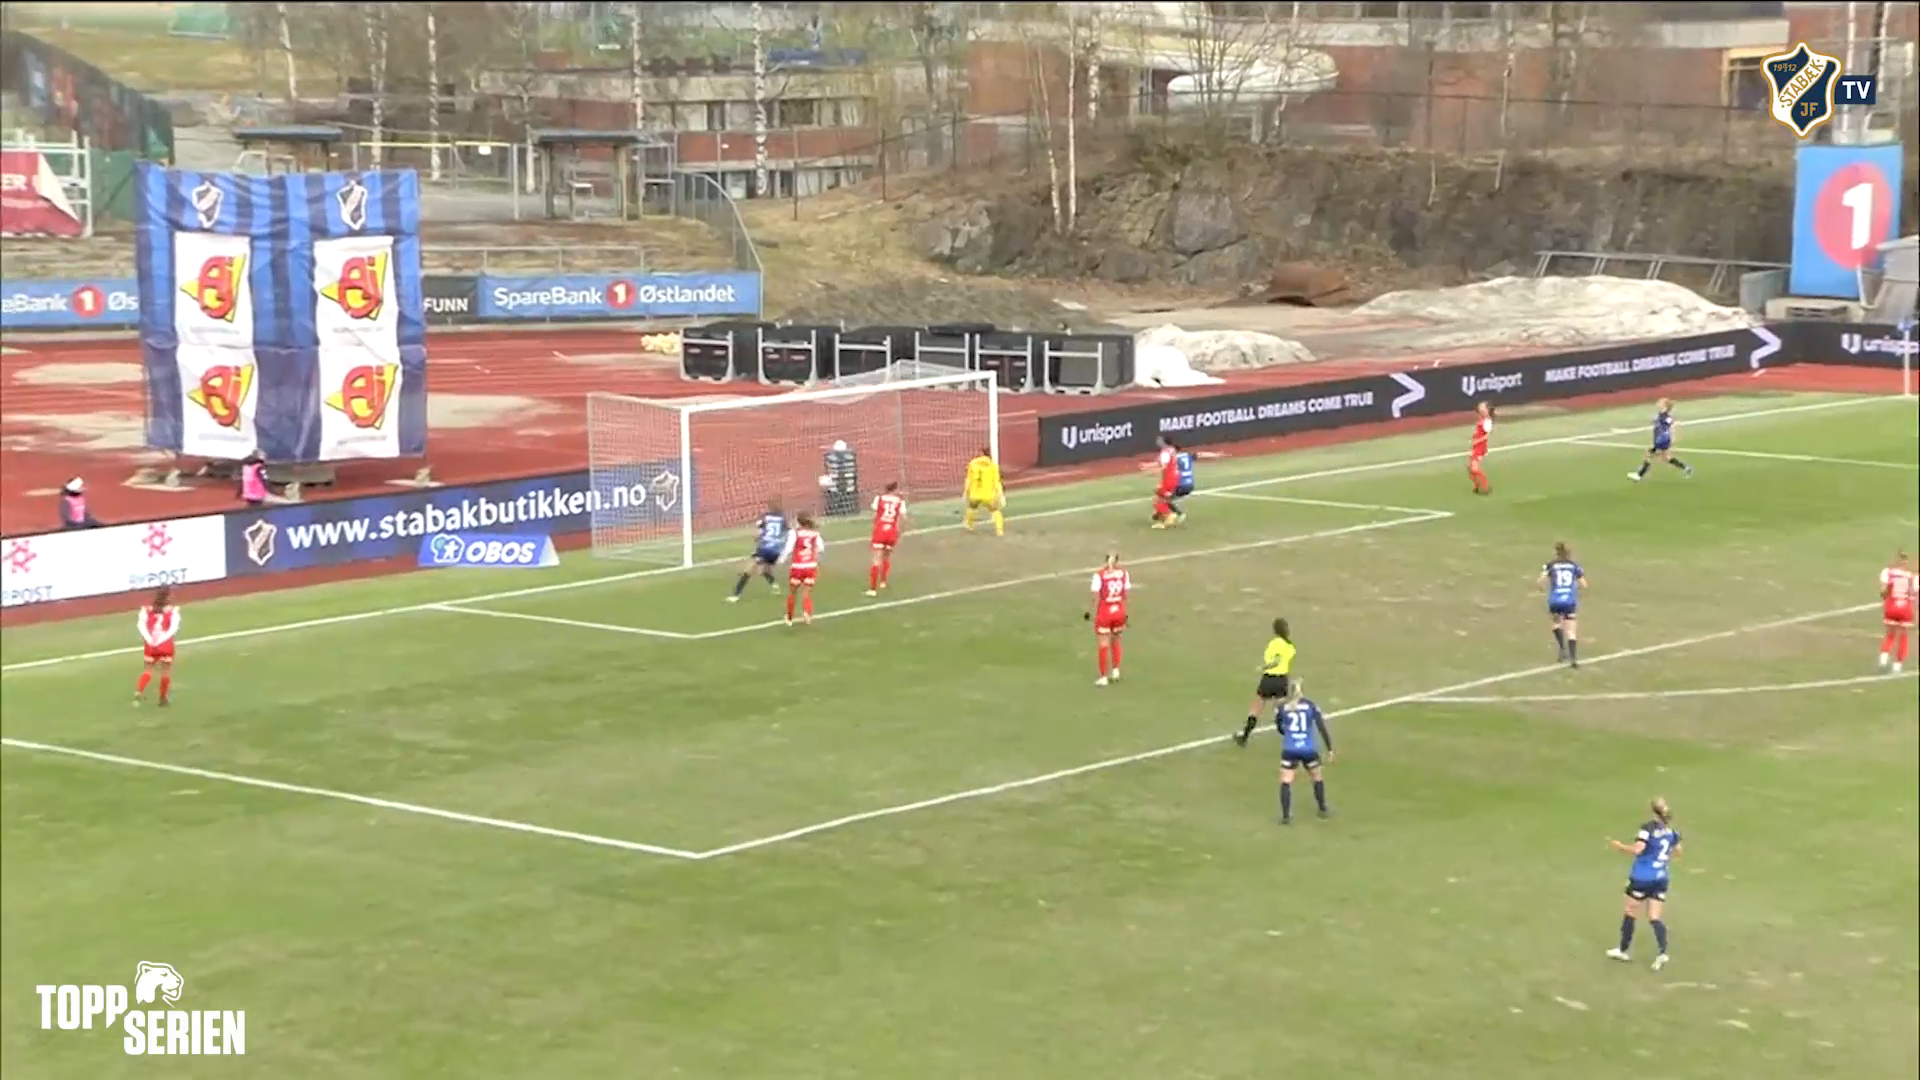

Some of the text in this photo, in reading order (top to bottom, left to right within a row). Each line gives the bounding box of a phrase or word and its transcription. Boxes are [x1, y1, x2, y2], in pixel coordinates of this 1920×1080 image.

[1842, 182, 1873, 250] 1
[79, 289, 95, 312] 1
[494, 283, 736, 309] SpareBank 1 Østlandet
[1545, 366, 1577, 382] MAKE
[1578, 360, 1631, 378] FOOTBALL
[1632, 353, 1676, 371] DREAMS
[1677, 348, 1707, 365] COME
[1079, 422, 1133, 445] unisport
[1159, 415, 1194, 432] MAKE
[1196, 407, 1255, 427] FOOTBALL
[1258, 400, 1306, 418] DREAMS
[1308, 395, 1342, 412] COME
[1344, 391, 1374, 407] TRUE
[287, 481, 646, 551] www.stabakbutikken.no
[466, 540, 536, 564] OBOS
[1555, 569, 1573, 587] 19
[1286, 711, 1307, 732] 21
[1657, 838, 1670, 861] 2
